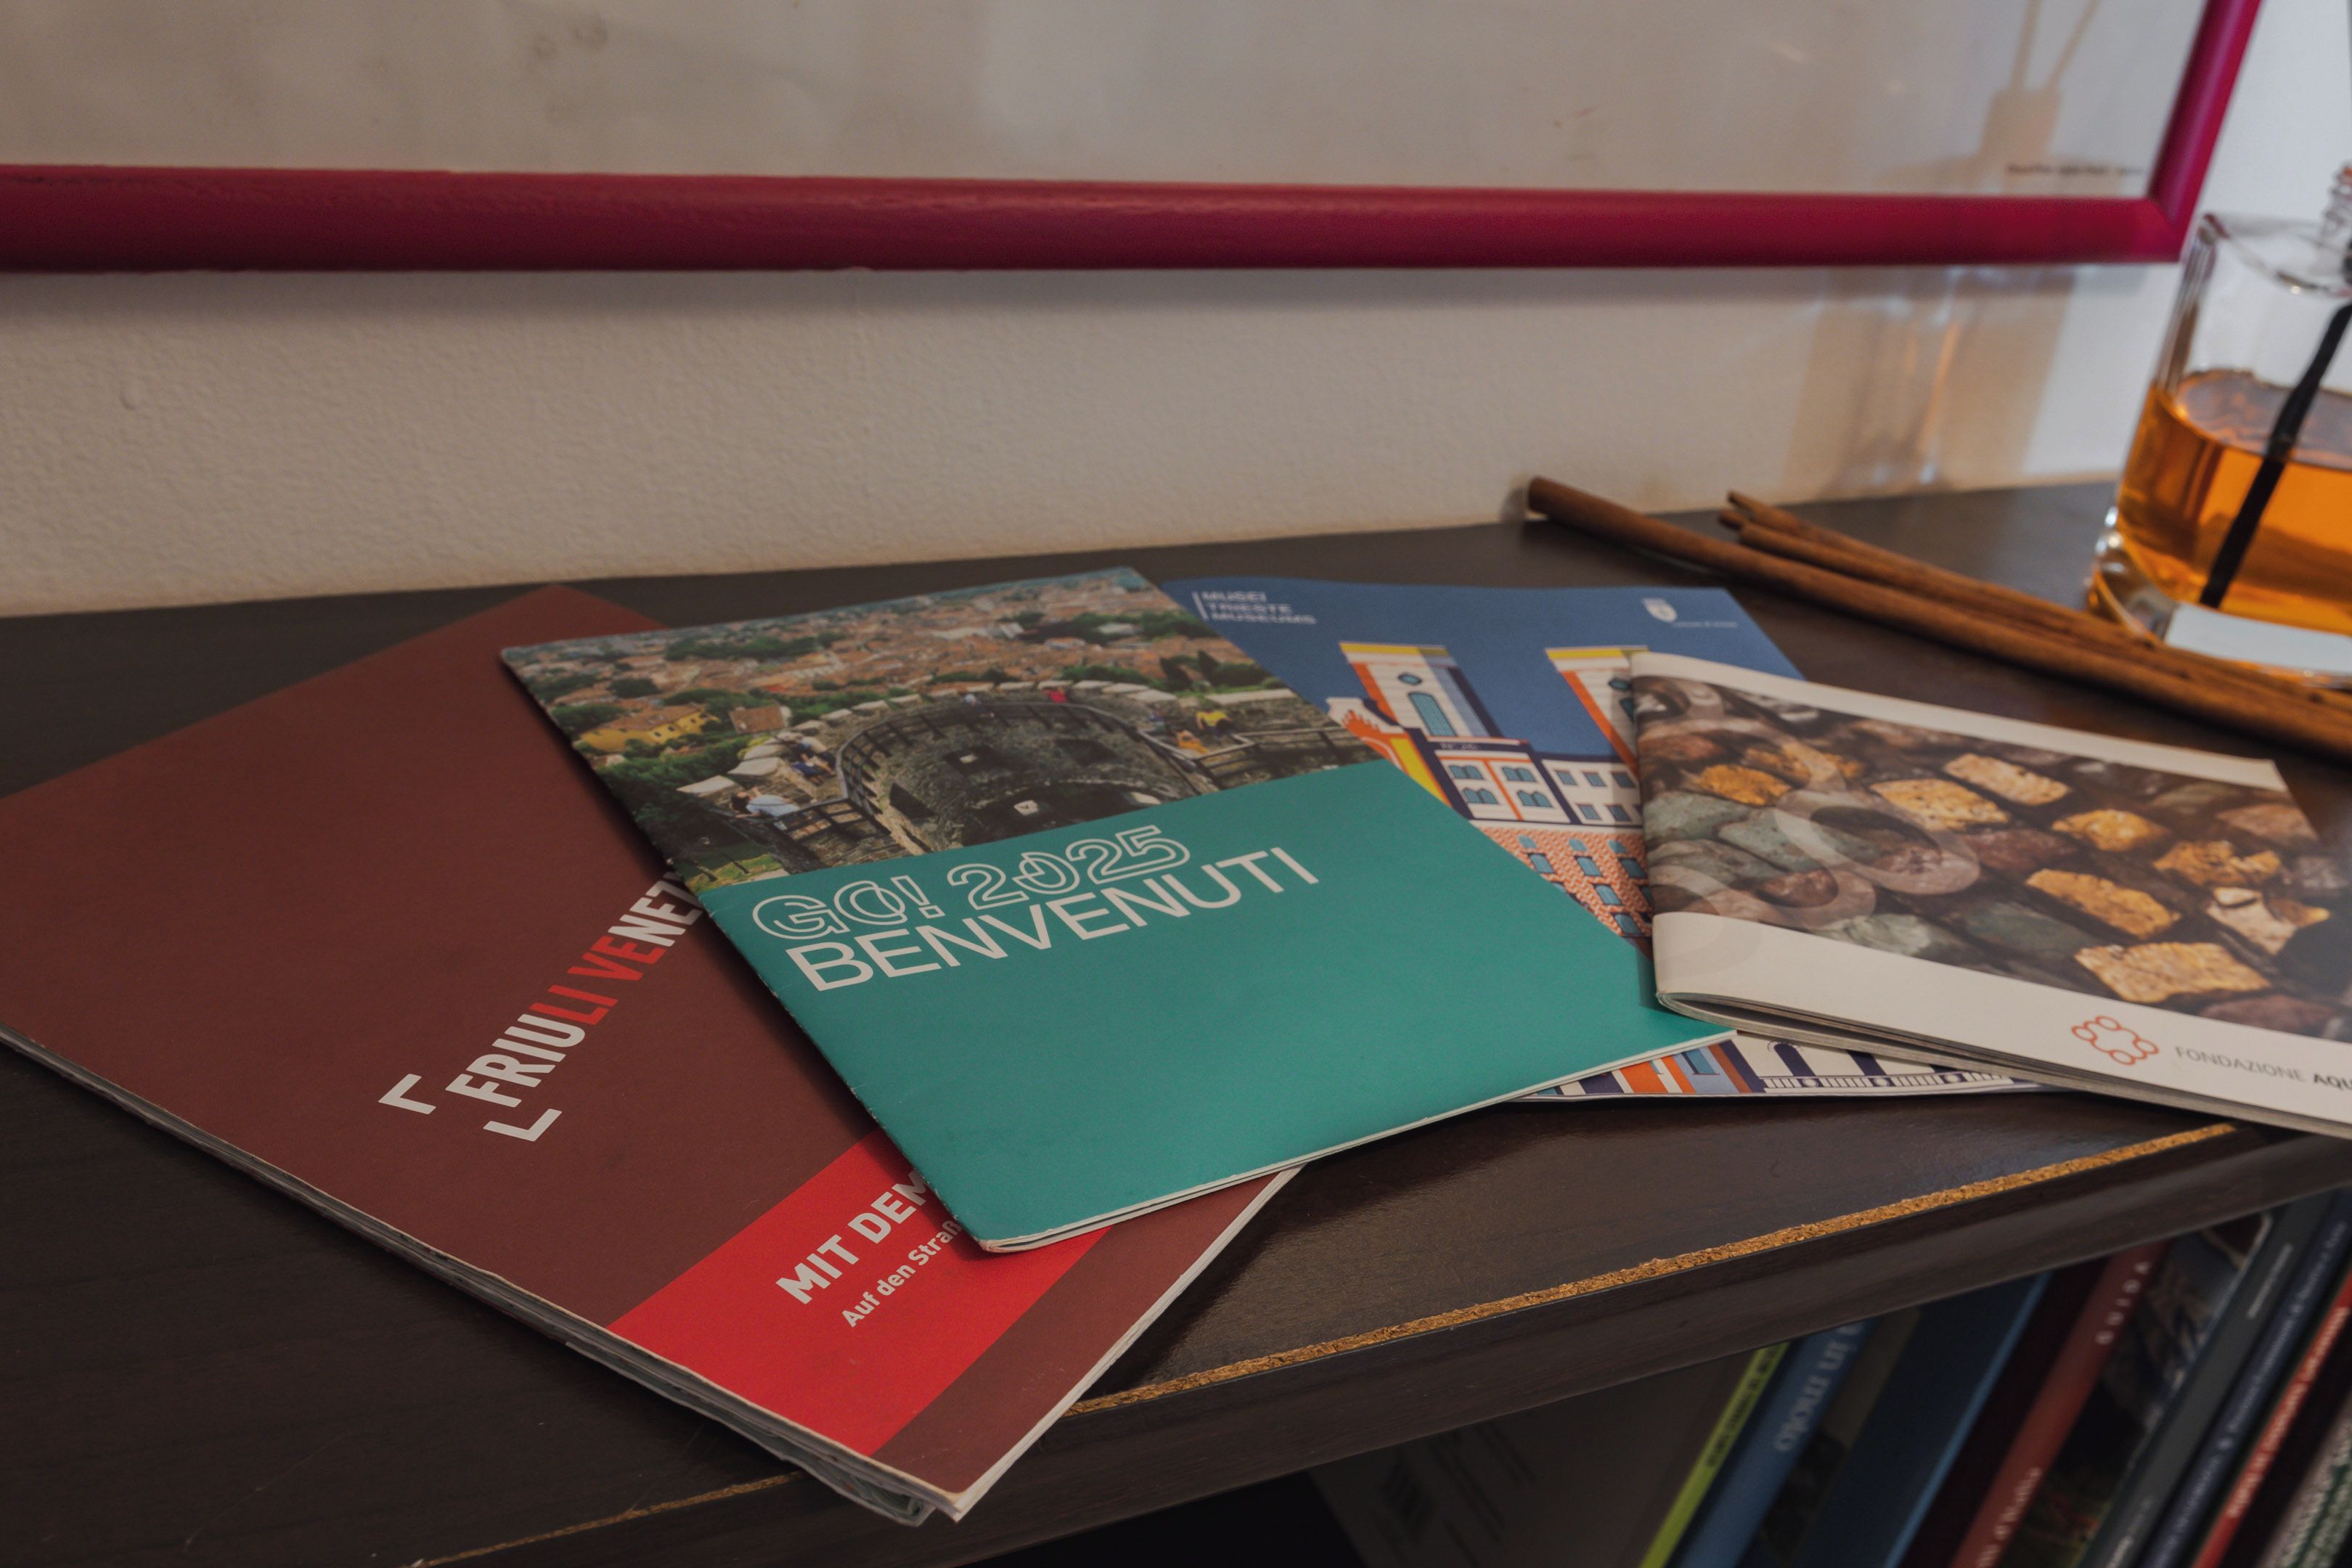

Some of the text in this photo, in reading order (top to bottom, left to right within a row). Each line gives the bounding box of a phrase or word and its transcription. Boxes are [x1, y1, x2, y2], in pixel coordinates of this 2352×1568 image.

[1201, 591, 1267, 602] MUSEI
[1207, 603, 1293, 615] TRIESTE
[752, 824, 1191, 941] GO! 2025
[785, 846, 1320, 992] BENVENUTI
[445, 985, 618, 1107] FRIULI
[2176, 1046, 2306, 1081] FONDAZIONE
[775, 1170, 927, 1304] MIT DEM
[842, 1291, 881, 1327] Auf
[877, 1262, 916, 1296] den
[2094, 1260, 2150, 1347] GUIDA
